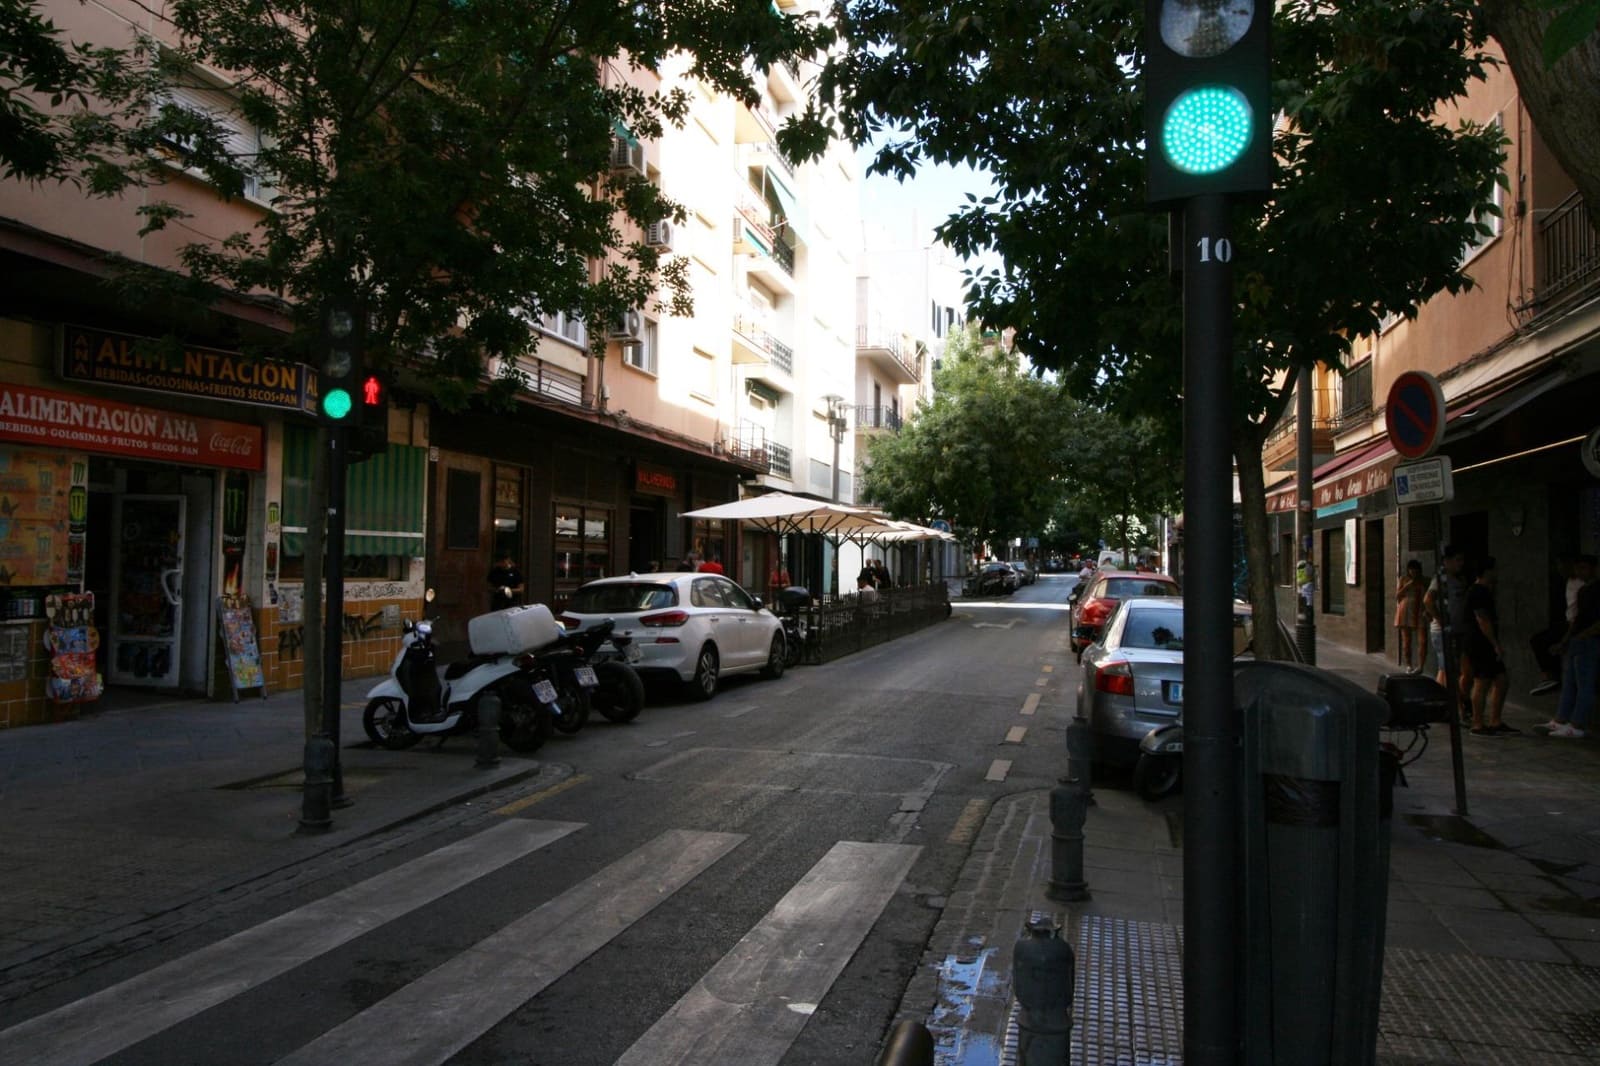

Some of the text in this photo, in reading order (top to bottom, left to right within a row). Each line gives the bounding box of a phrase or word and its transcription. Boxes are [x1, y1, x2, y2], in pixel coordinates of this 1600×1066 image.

[1197, 237, 1232, 263] 10
[95, 335, 297, 391] ALIMNTACIÓN
[96, 366, 141, 385] BEBIDAS
[146, 374, 204, 393] GOLOSINAS
[208, 382, 246, 398] FRUTOS
[247, 387, 276, 403] SECOS
[279, 392, 297, 406] PAN
[0, 390, 199, 443] ALIMENTACIÓN ANA
[50, 427, 108, 444] GOLOSINAS
[111, 436, 148, 449] FRUTOS
[152, 441, 178, 453] SECOS
[181, 446, 199, 456] PAN
